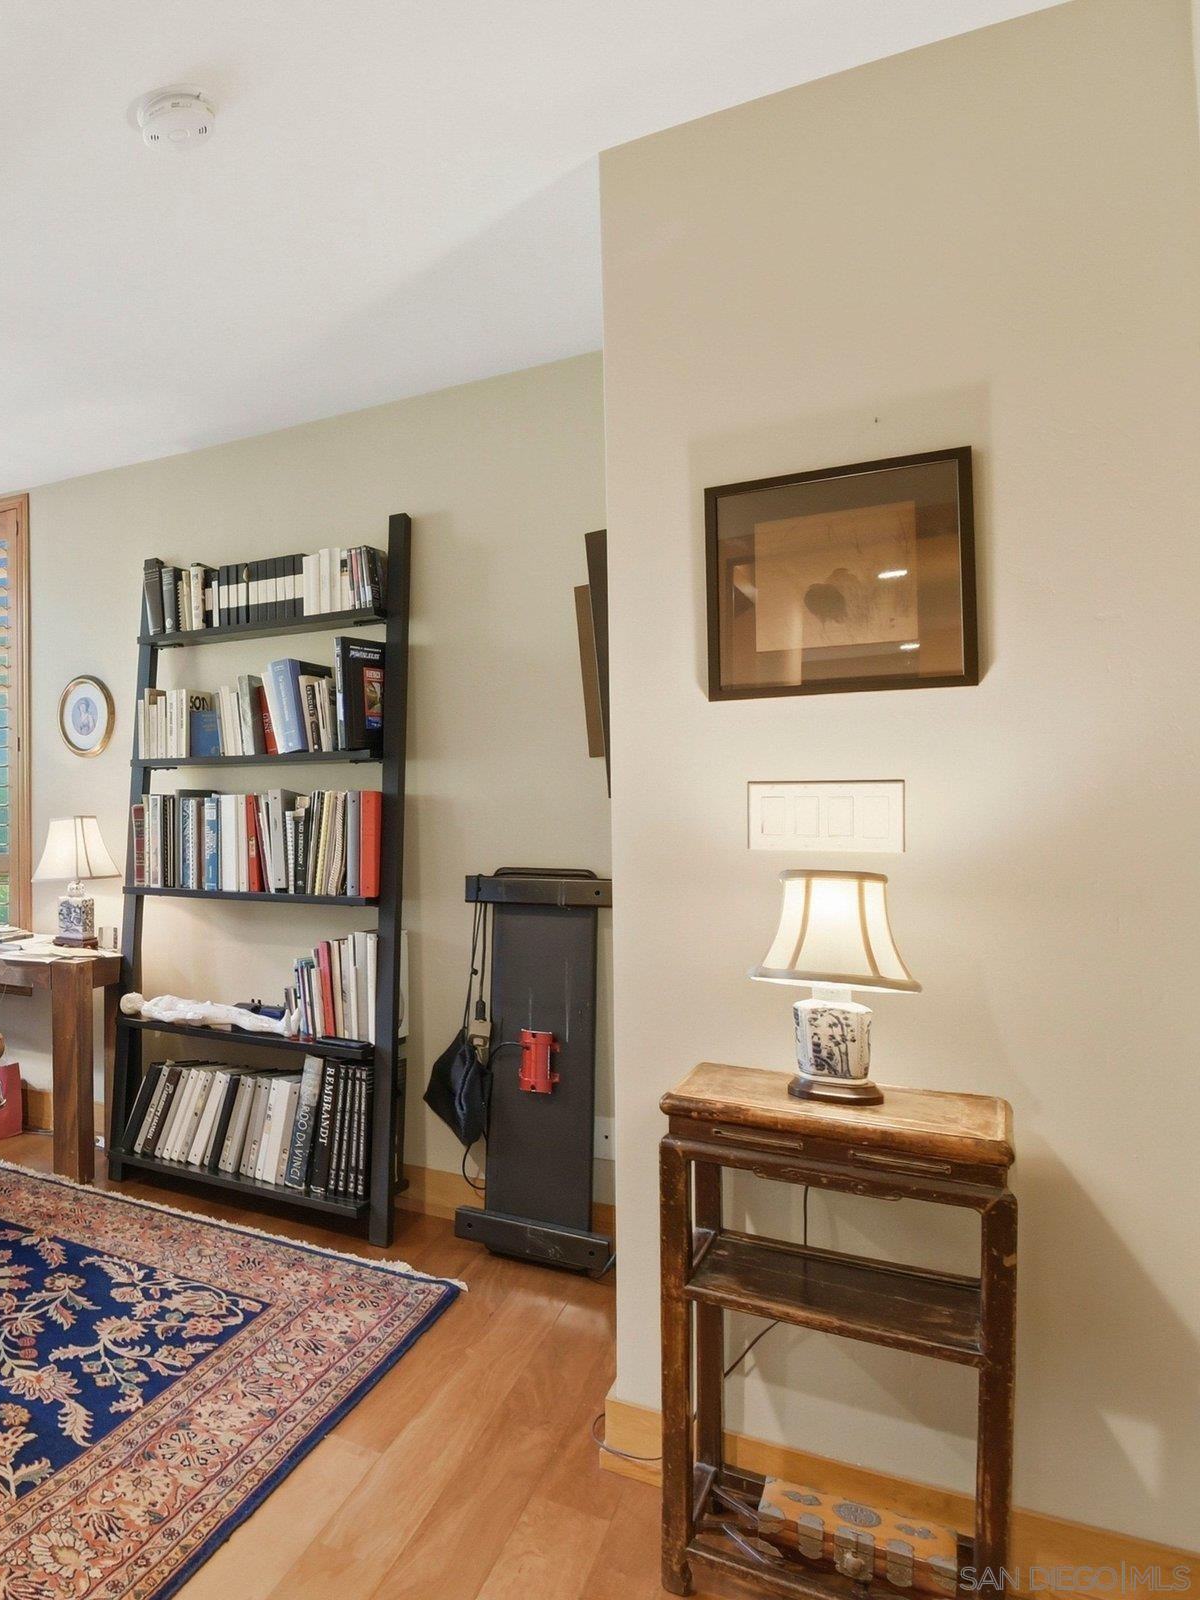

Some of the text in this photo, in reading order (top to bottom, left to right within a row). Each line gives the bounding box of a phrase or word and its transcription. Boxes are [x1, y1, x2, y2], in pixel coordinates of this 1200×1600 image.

[318, 1067, 335, 1146] REMBRANDT
[294, 1132, 306, 1147] DA
[290, 1147, 302, 1181] VINCI
